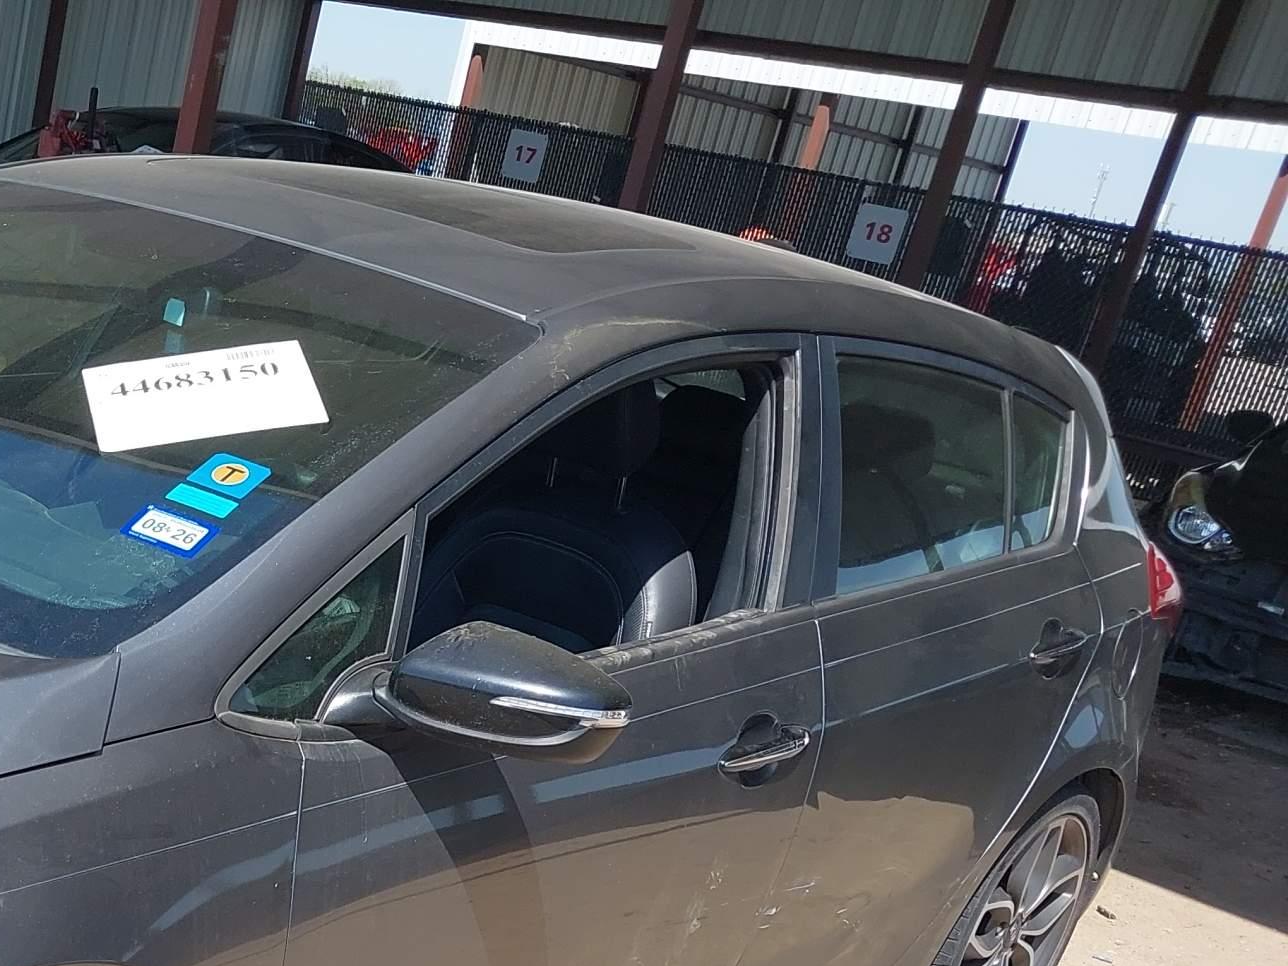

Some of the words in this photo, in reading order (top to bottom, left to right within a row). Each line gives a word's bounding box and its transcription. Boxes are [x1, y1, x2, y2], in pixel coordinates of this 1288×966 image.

[515, 145, 537, 164] 17
[865, 222, 893, 243] 18
[110, 361, 280, 397] 44683150
[221, 466, 245, 482] T
[141, 518, 167, 533] 08
[170, 529, 198, 545] 26
